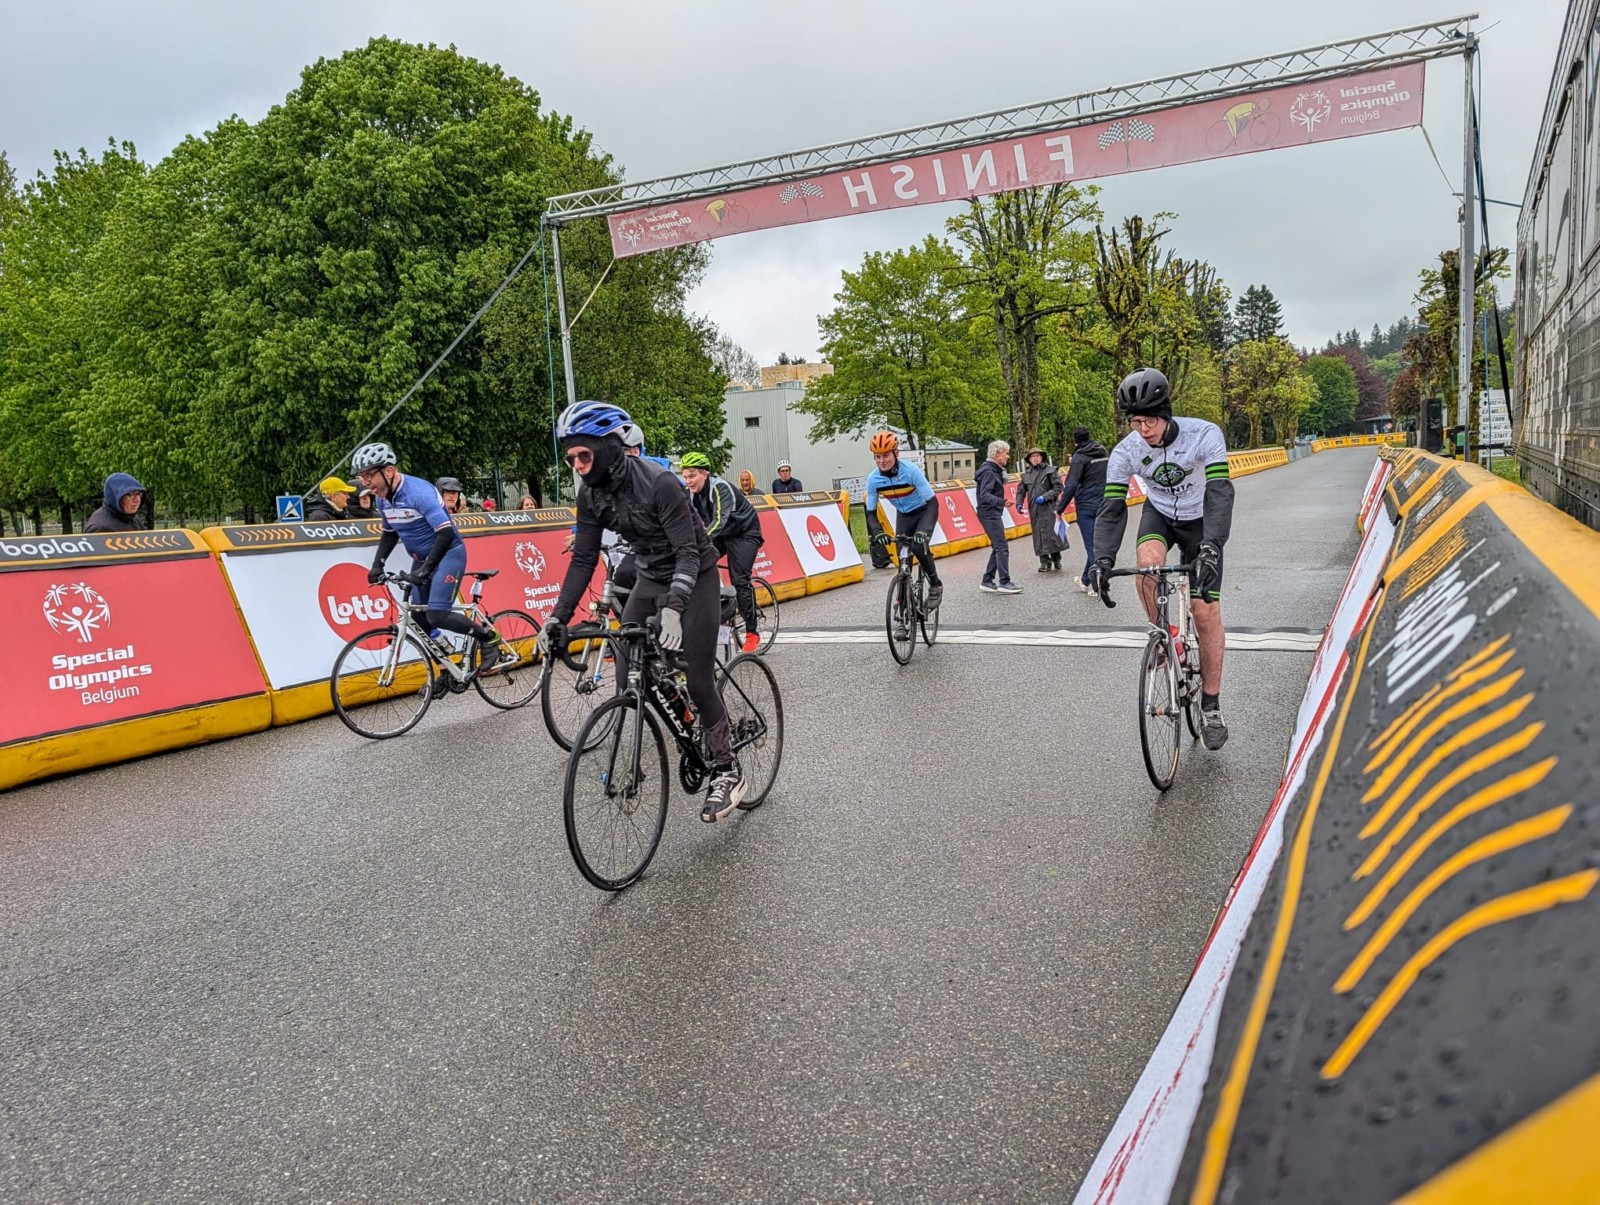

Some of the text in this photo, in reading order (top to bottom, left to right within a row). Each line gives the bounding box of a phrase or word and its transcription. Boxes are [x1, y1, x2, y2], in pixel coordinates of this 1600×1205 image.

[301, 522, 362, 540] boplan
[524, 582, 561, 599] Special
[525, 595, 560, 611] Olympi
[51, 644, 135, 671] Special
[48, 663, 153, 691] Olympics
[81, 685, 140, 706] Belgium
[651, 684, 690, 740] RIDLEY
